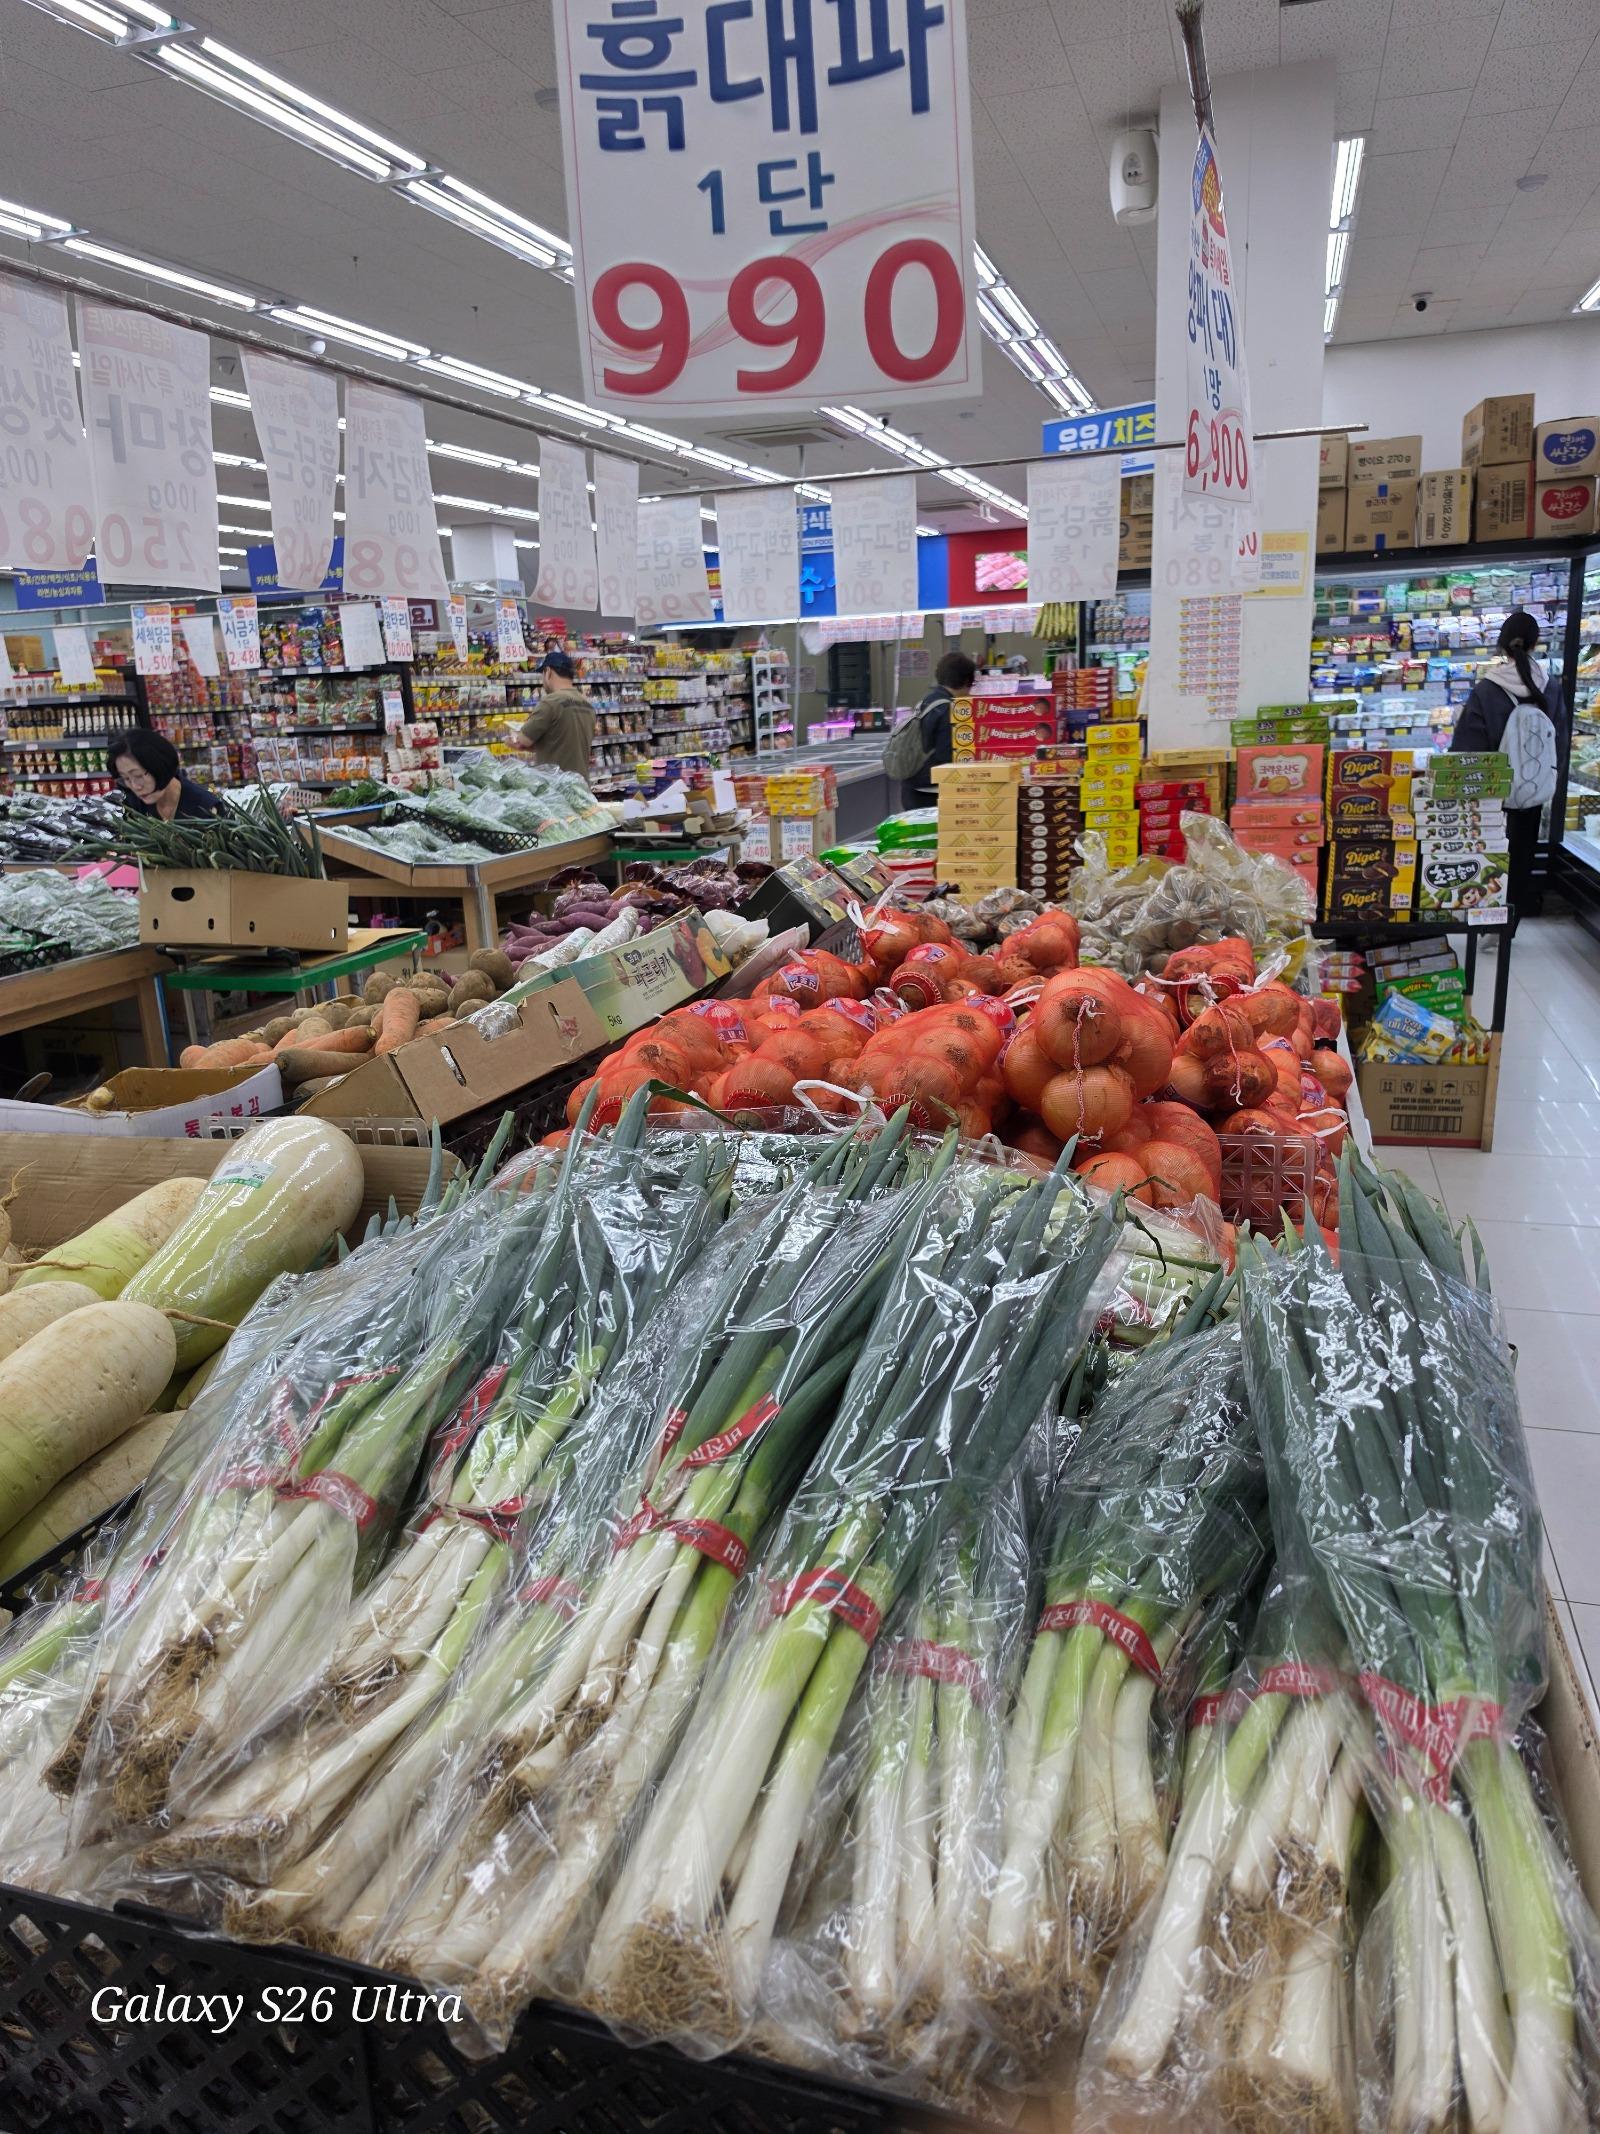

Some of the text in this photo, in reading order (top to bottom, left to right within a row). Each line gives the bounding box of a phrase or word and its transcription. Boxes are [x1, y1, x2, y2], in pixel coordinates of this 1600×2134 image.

[580, 0, 945, 152] 흙대파
[697, 151, 835, 236] 1 단
[592, 238, 965, 396] 990
[1058, 412, 1155, 452] 우유/치즈
[1186, 410, 1249, 491] 6,900
[136, 626, 170, 644] 세척당근
[225, 619, 257, 638] 시금치
[1259, 764, 1301, 776] 크라운산도
[1343, 759, 1380, 777] Diget
[1340, 800, 1377, 815] Diget
[1345, 849, 1381, 866] Diget
[1429, 864, 1476, 885] 초코송이
[1341, 891, 1377, 908] Diget
[607, 1015, 623, 1027] 5kg
